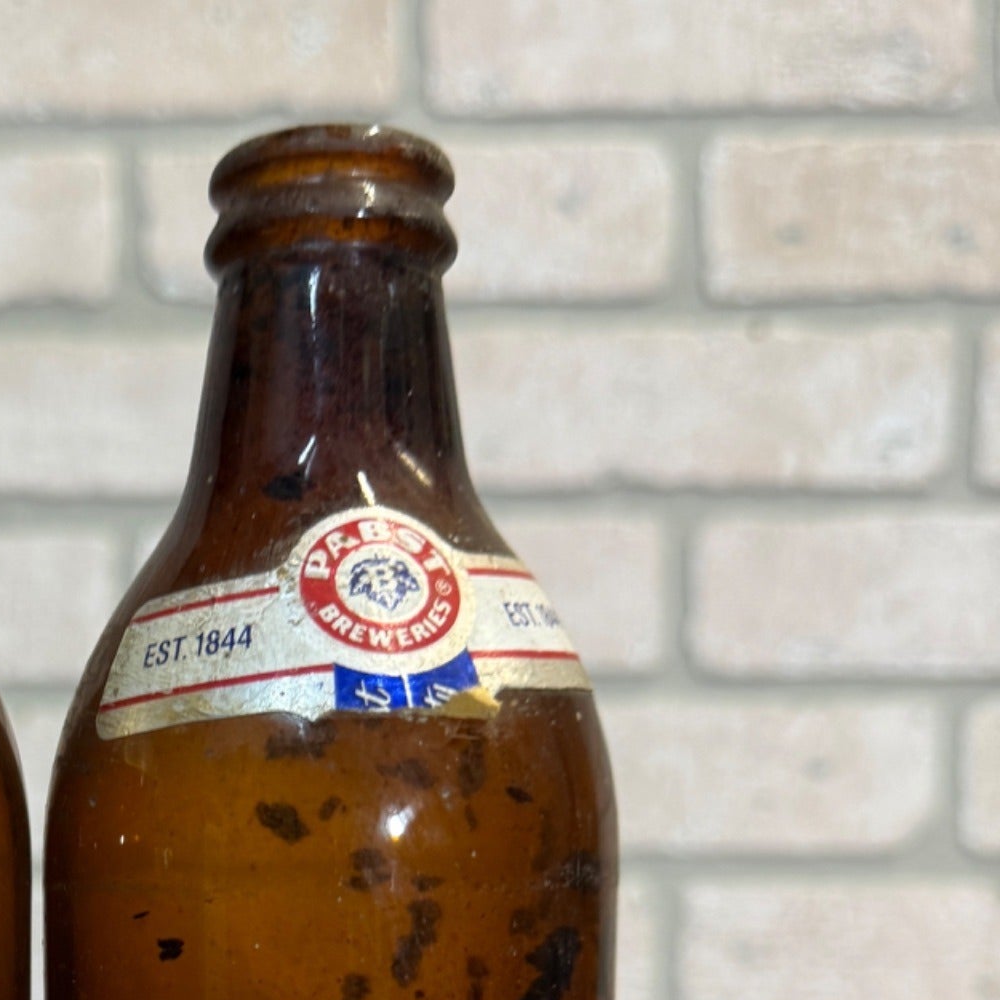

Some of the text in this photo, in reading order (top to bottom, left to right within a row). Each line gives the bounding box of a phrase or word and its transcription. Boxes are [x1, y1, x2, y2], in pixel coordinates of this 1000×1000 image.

[303, 517, 451, 582] PABST
[144, 624, 253, 668] EST. 1844
[317, 600, 452, 651] BREWERIES
